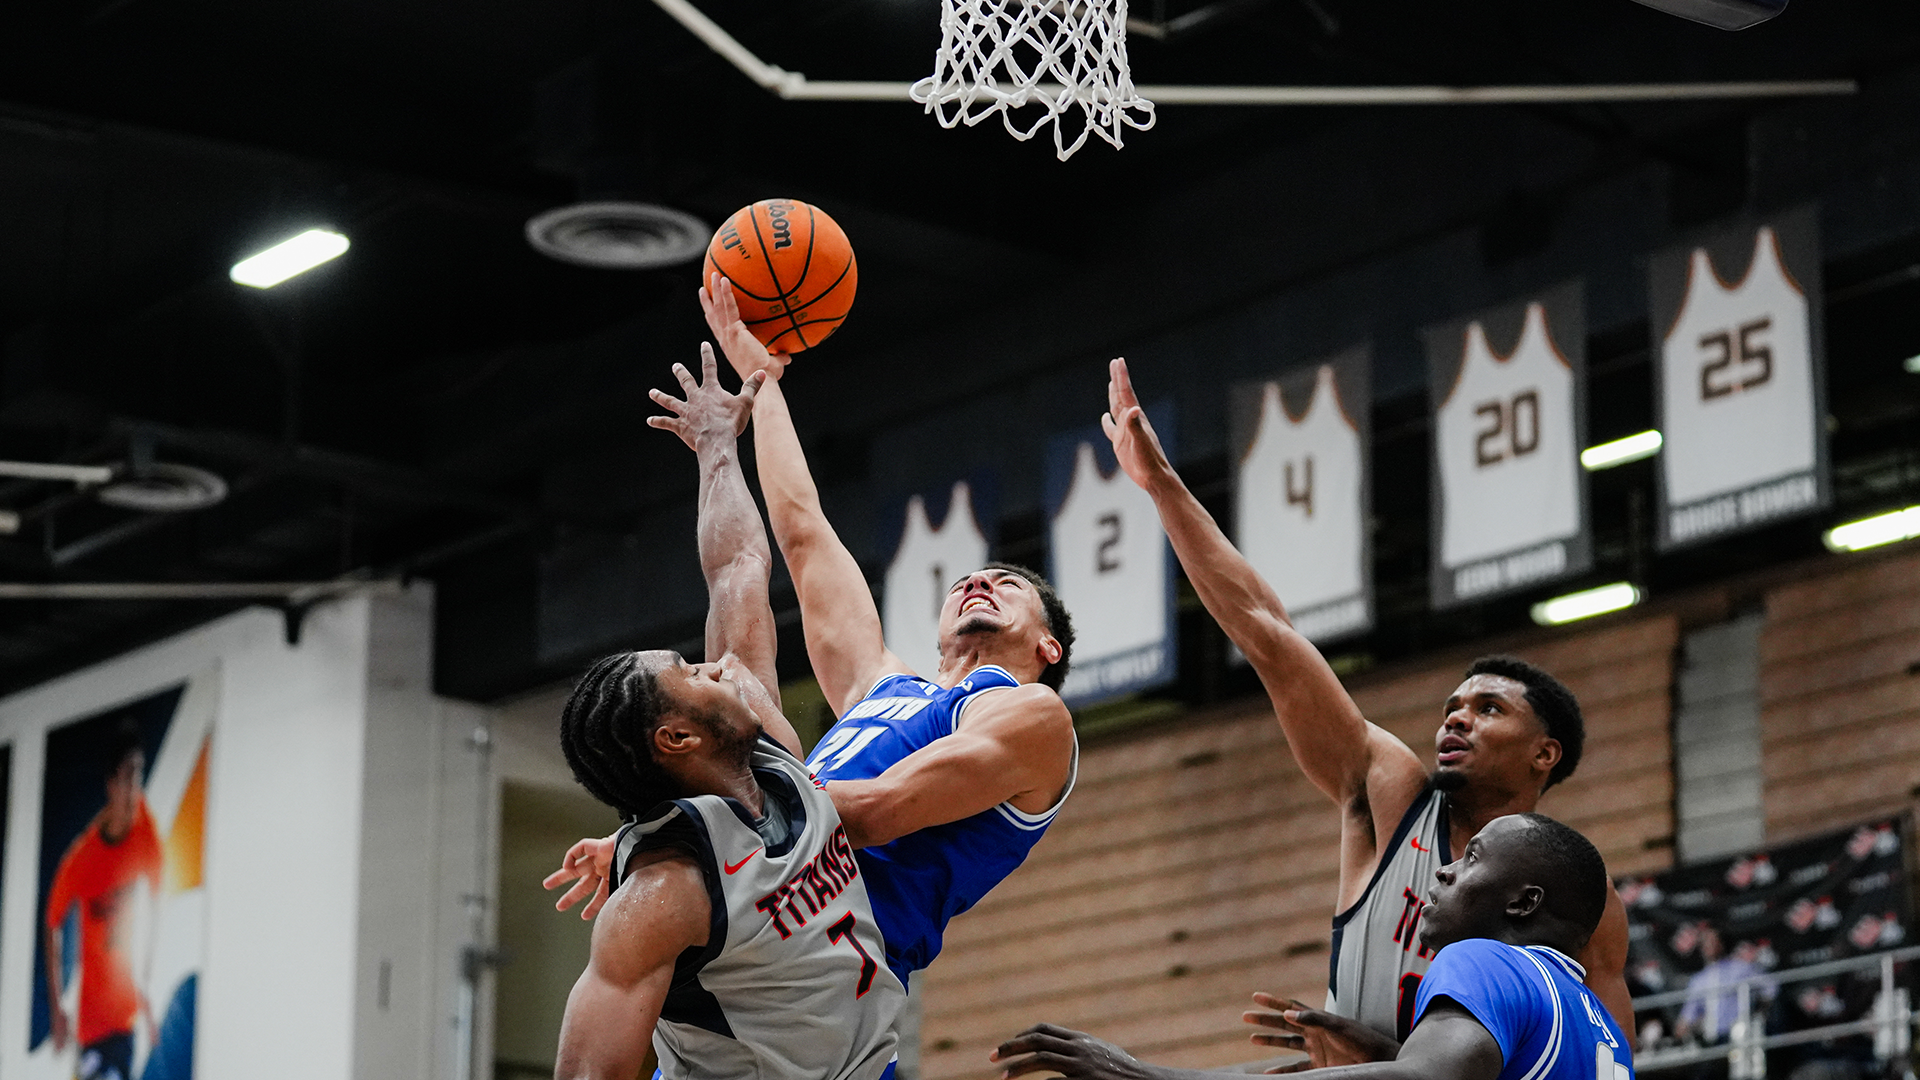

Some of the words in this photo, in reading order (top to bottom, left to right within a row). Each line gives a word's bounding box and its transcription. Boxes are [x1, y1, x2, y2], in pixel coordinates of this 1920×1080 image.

[1699, 315, 1773, 402] 25
[1475, 389, 1539, 468] 20
[1284, 455, 1313, 520] 4
[1096, 511, 1122, 573] 2
[755, 822, 858, 941] TITANS
[826, 910, 878, 1000] 7
